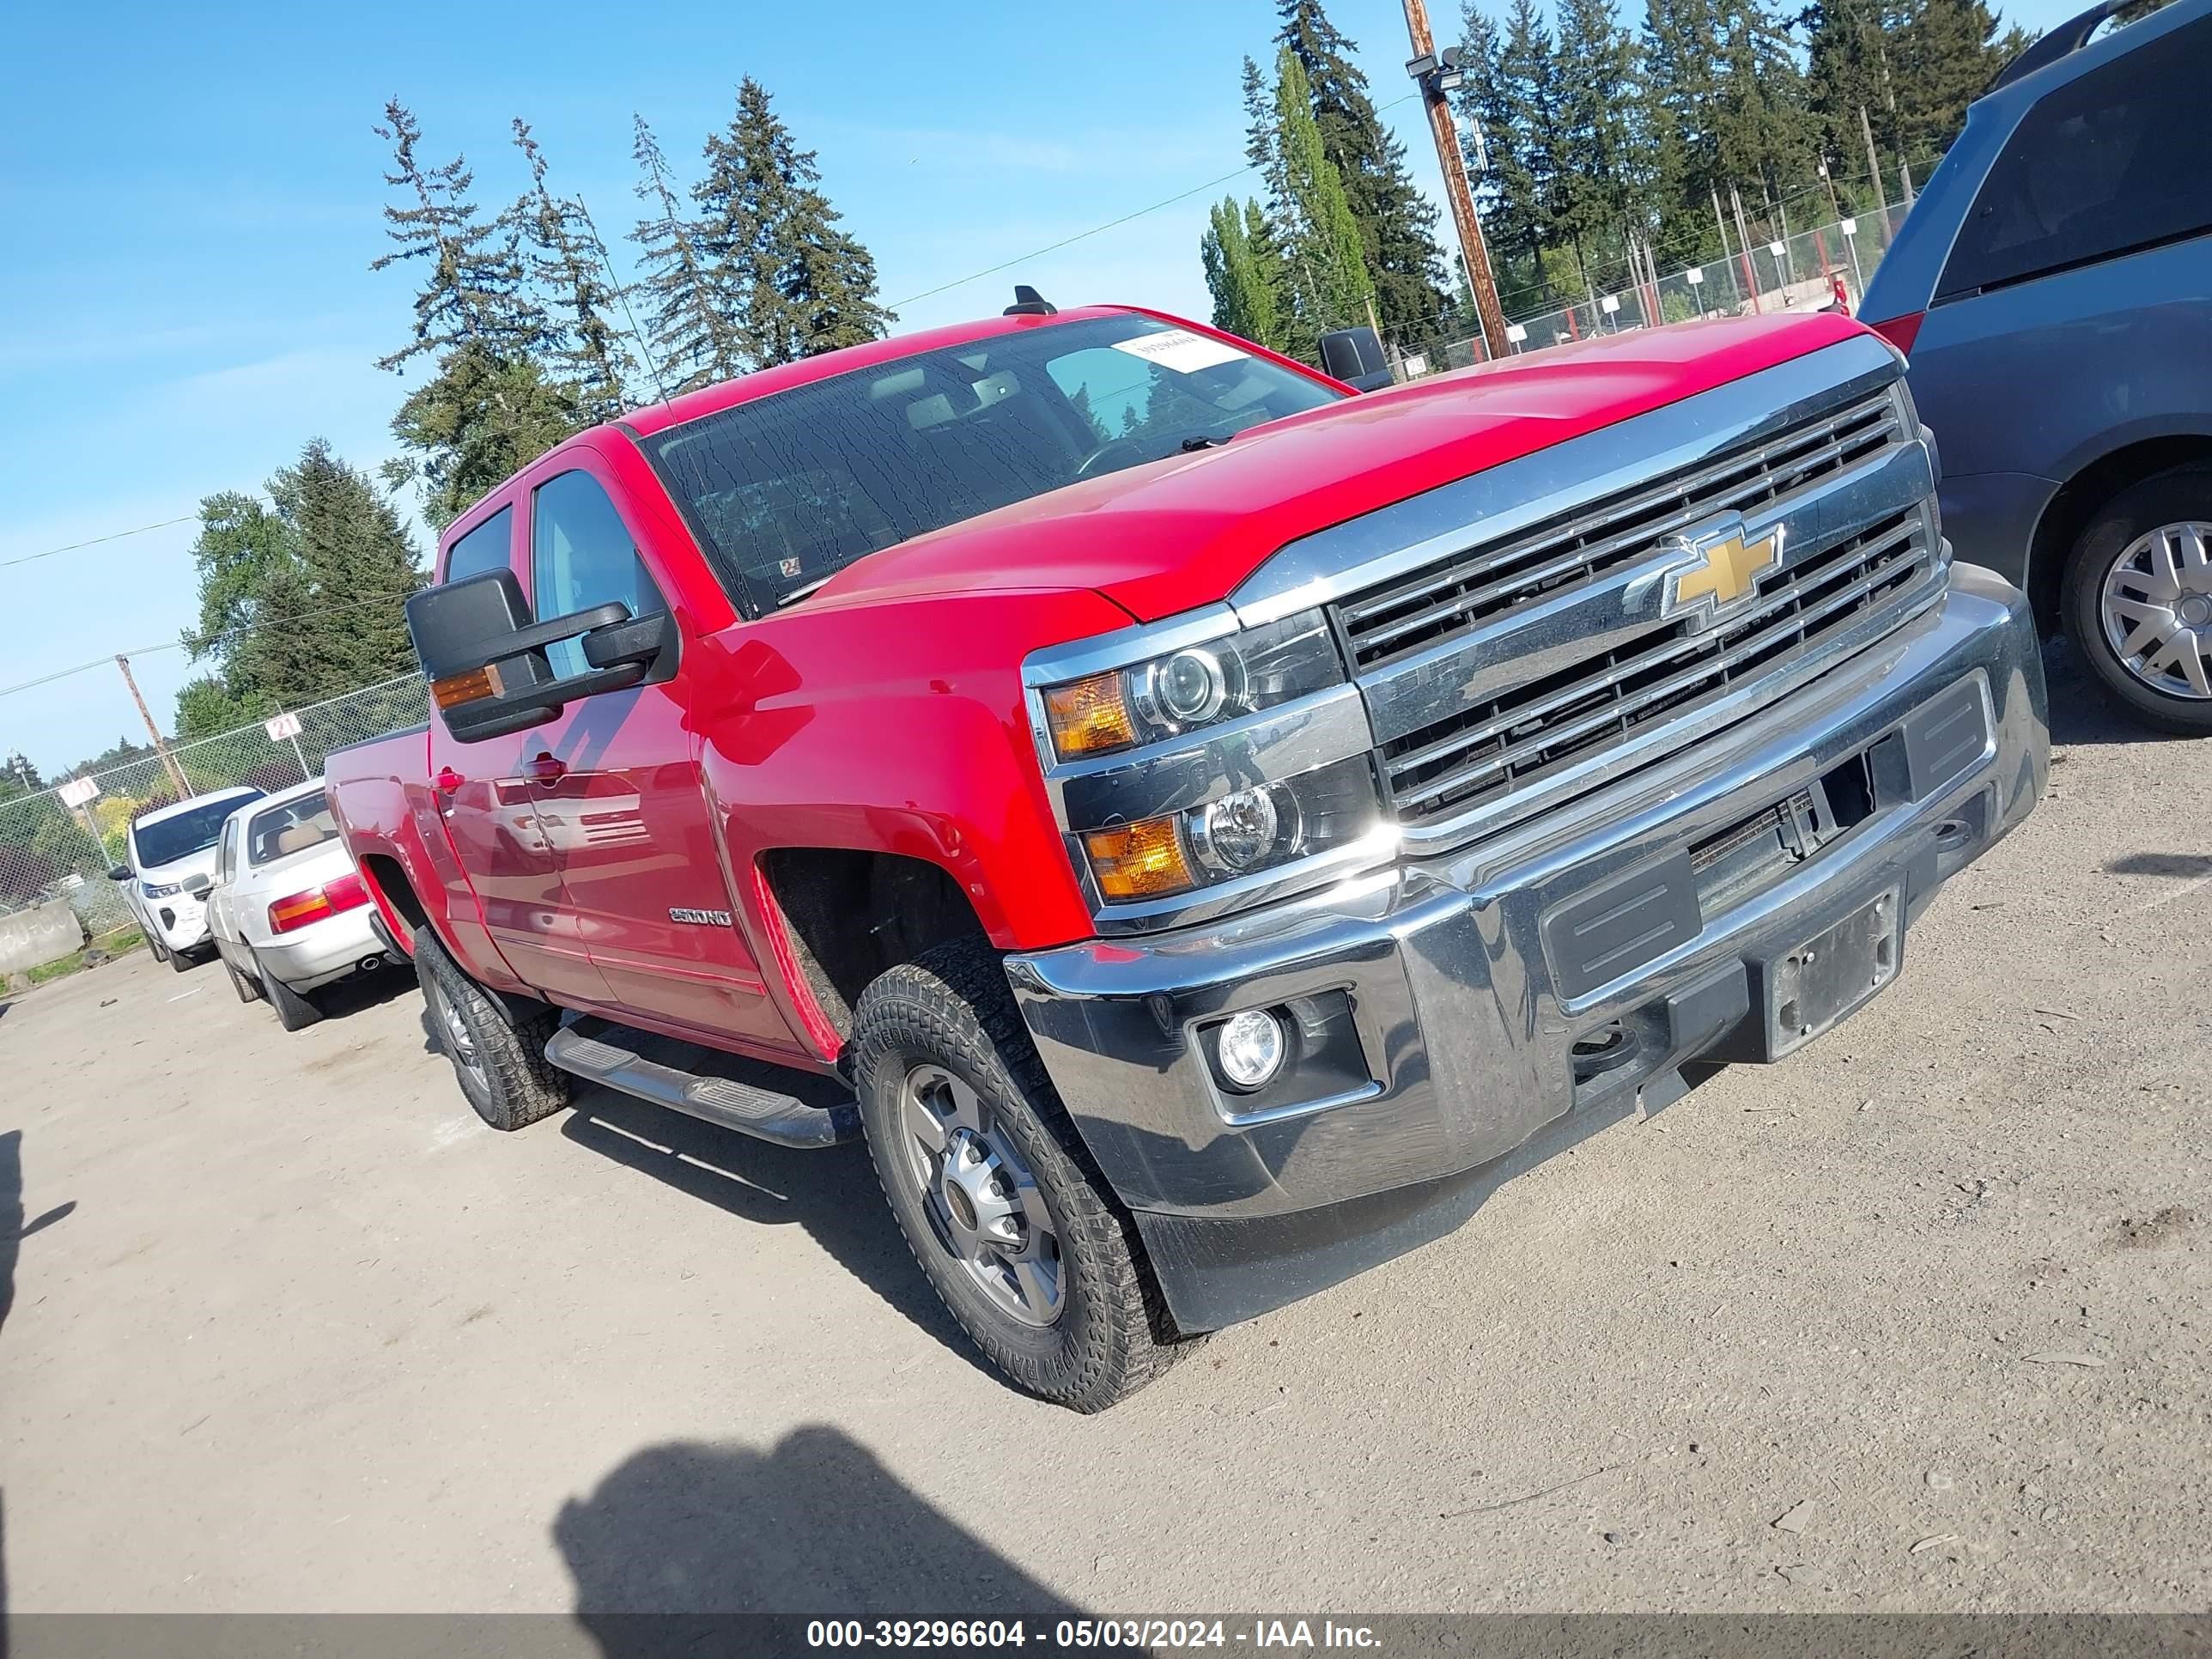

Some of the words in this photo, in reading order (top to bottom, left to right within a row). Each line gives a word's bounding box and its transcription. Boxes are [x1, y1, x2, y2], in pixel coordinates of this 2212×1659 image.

[1408, 358, 1424, 374] 29
[271, 716, 296, 737] 21
[860, 1044, 880, 1091] ALL
[872, 1026, 953, 1067] TERRAIN
[975, 1322, 1039, 1381] RANGE
[1044, 1332, 1080, 1381] OPEN
